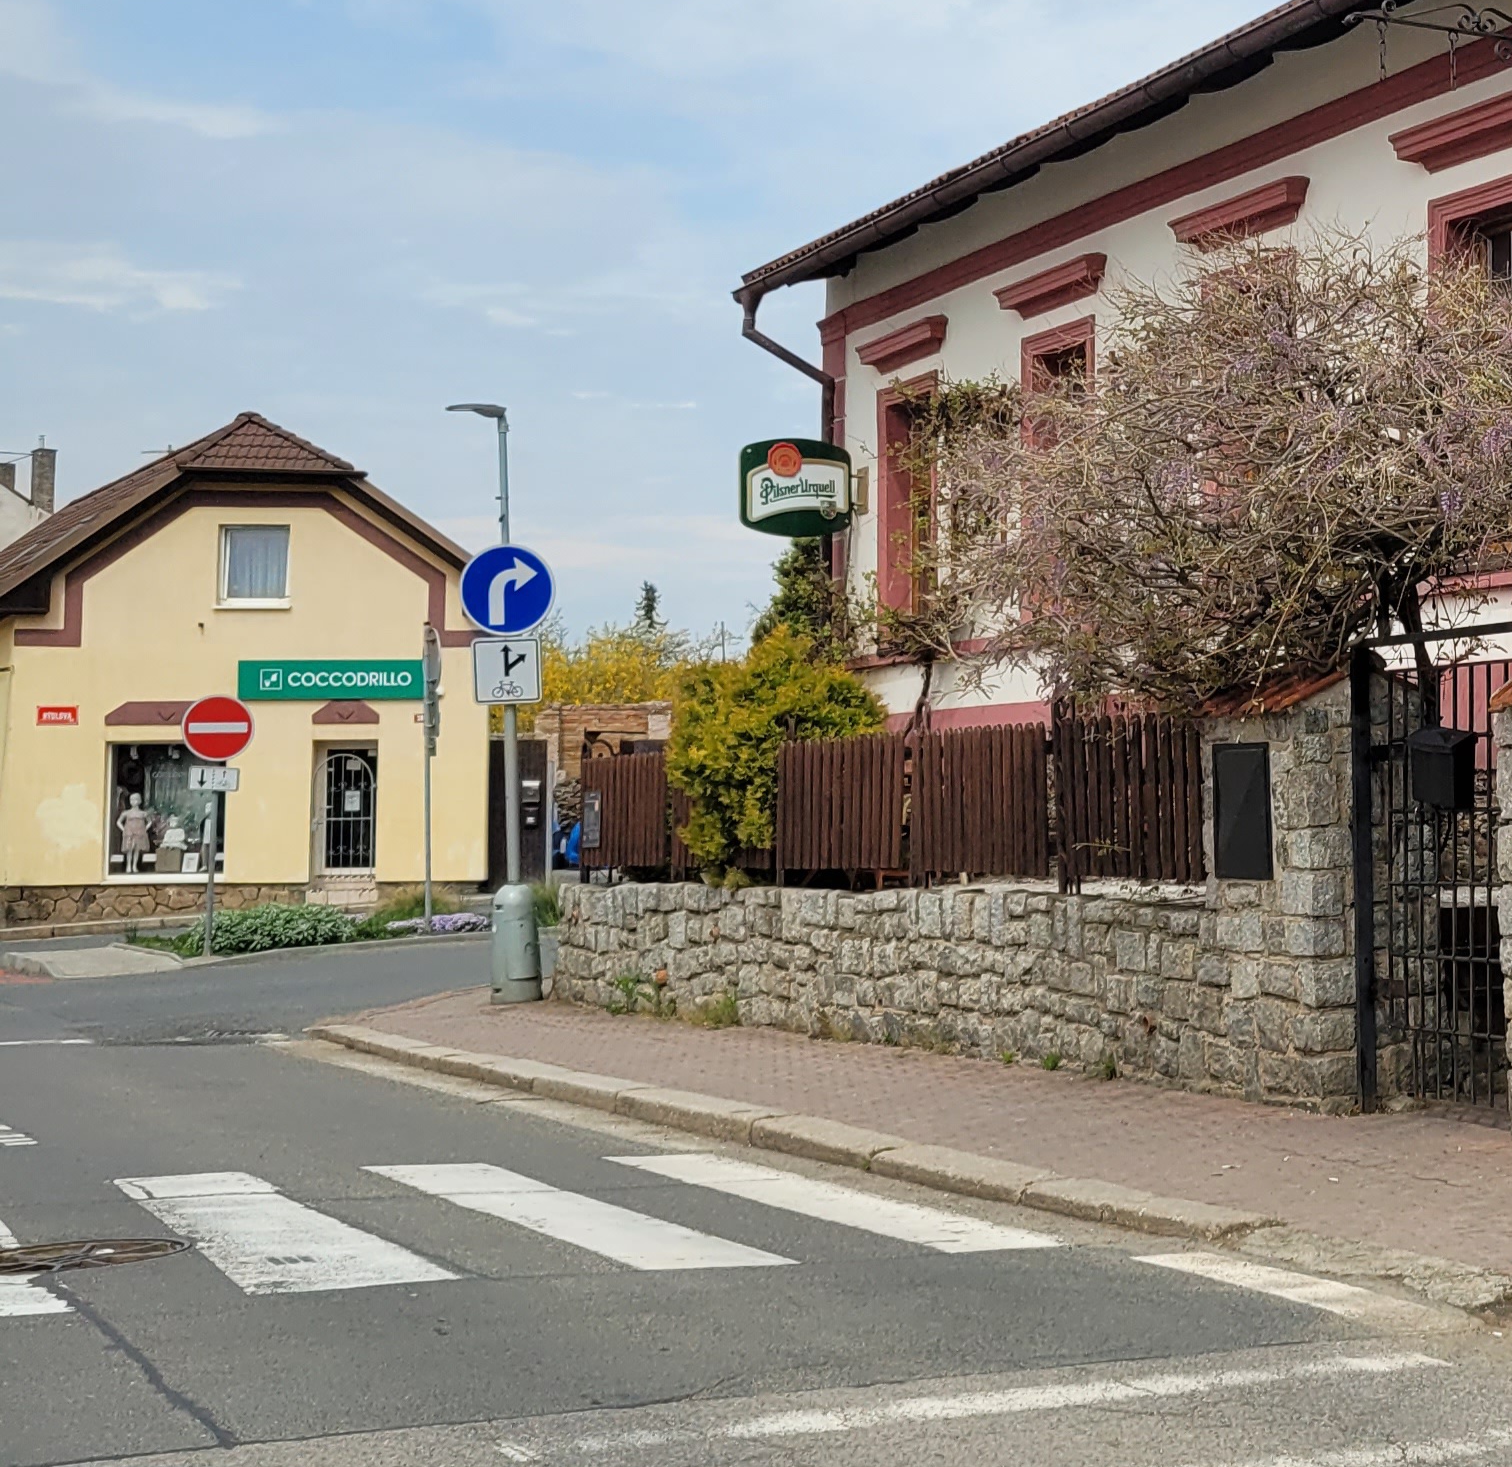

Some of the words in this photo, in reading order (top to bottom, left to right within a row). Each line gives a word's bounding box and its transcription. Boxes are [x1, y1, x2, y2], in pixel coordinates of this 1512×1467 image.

[760, 477, 799, 505] Pilsner
[799, 477, 836, 499] Urquell
[288, 672, 412, 687] COCCODRILLO
